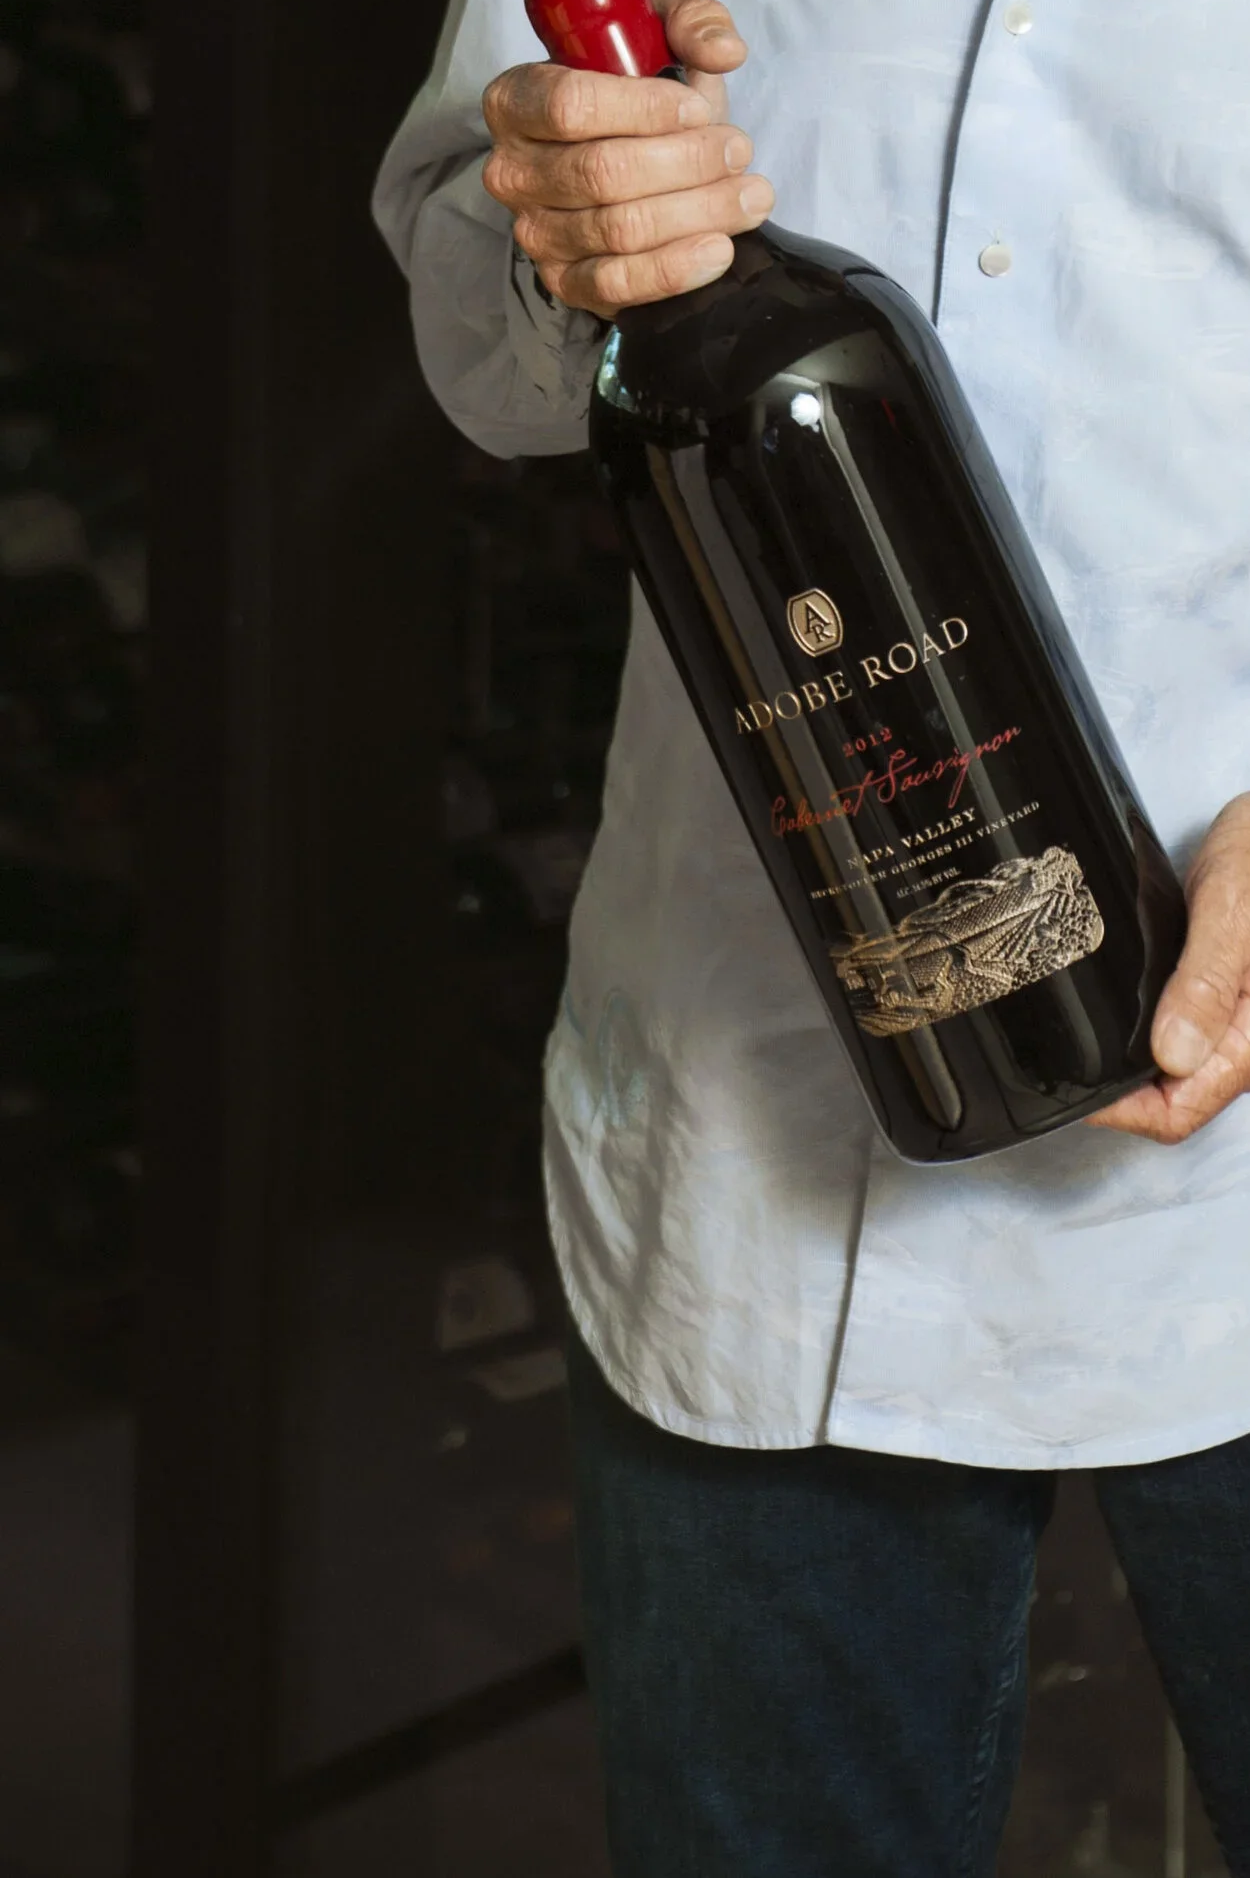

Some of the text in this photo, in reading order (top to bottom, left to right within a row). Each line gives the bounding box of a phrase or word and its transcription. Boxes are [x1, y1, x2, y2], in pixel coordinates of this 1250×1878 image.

[734, 617, 969, 735] ADOBE ROAD
[842, 726, 893, 758] 2012
[876, 726, 1021, 809] Sauvignon
[847, 807, 976, 870] NAPA VALLEY
[891, 843, 953, 875] GEORGES
[976, 801, 1040, 837] VINEYARD
